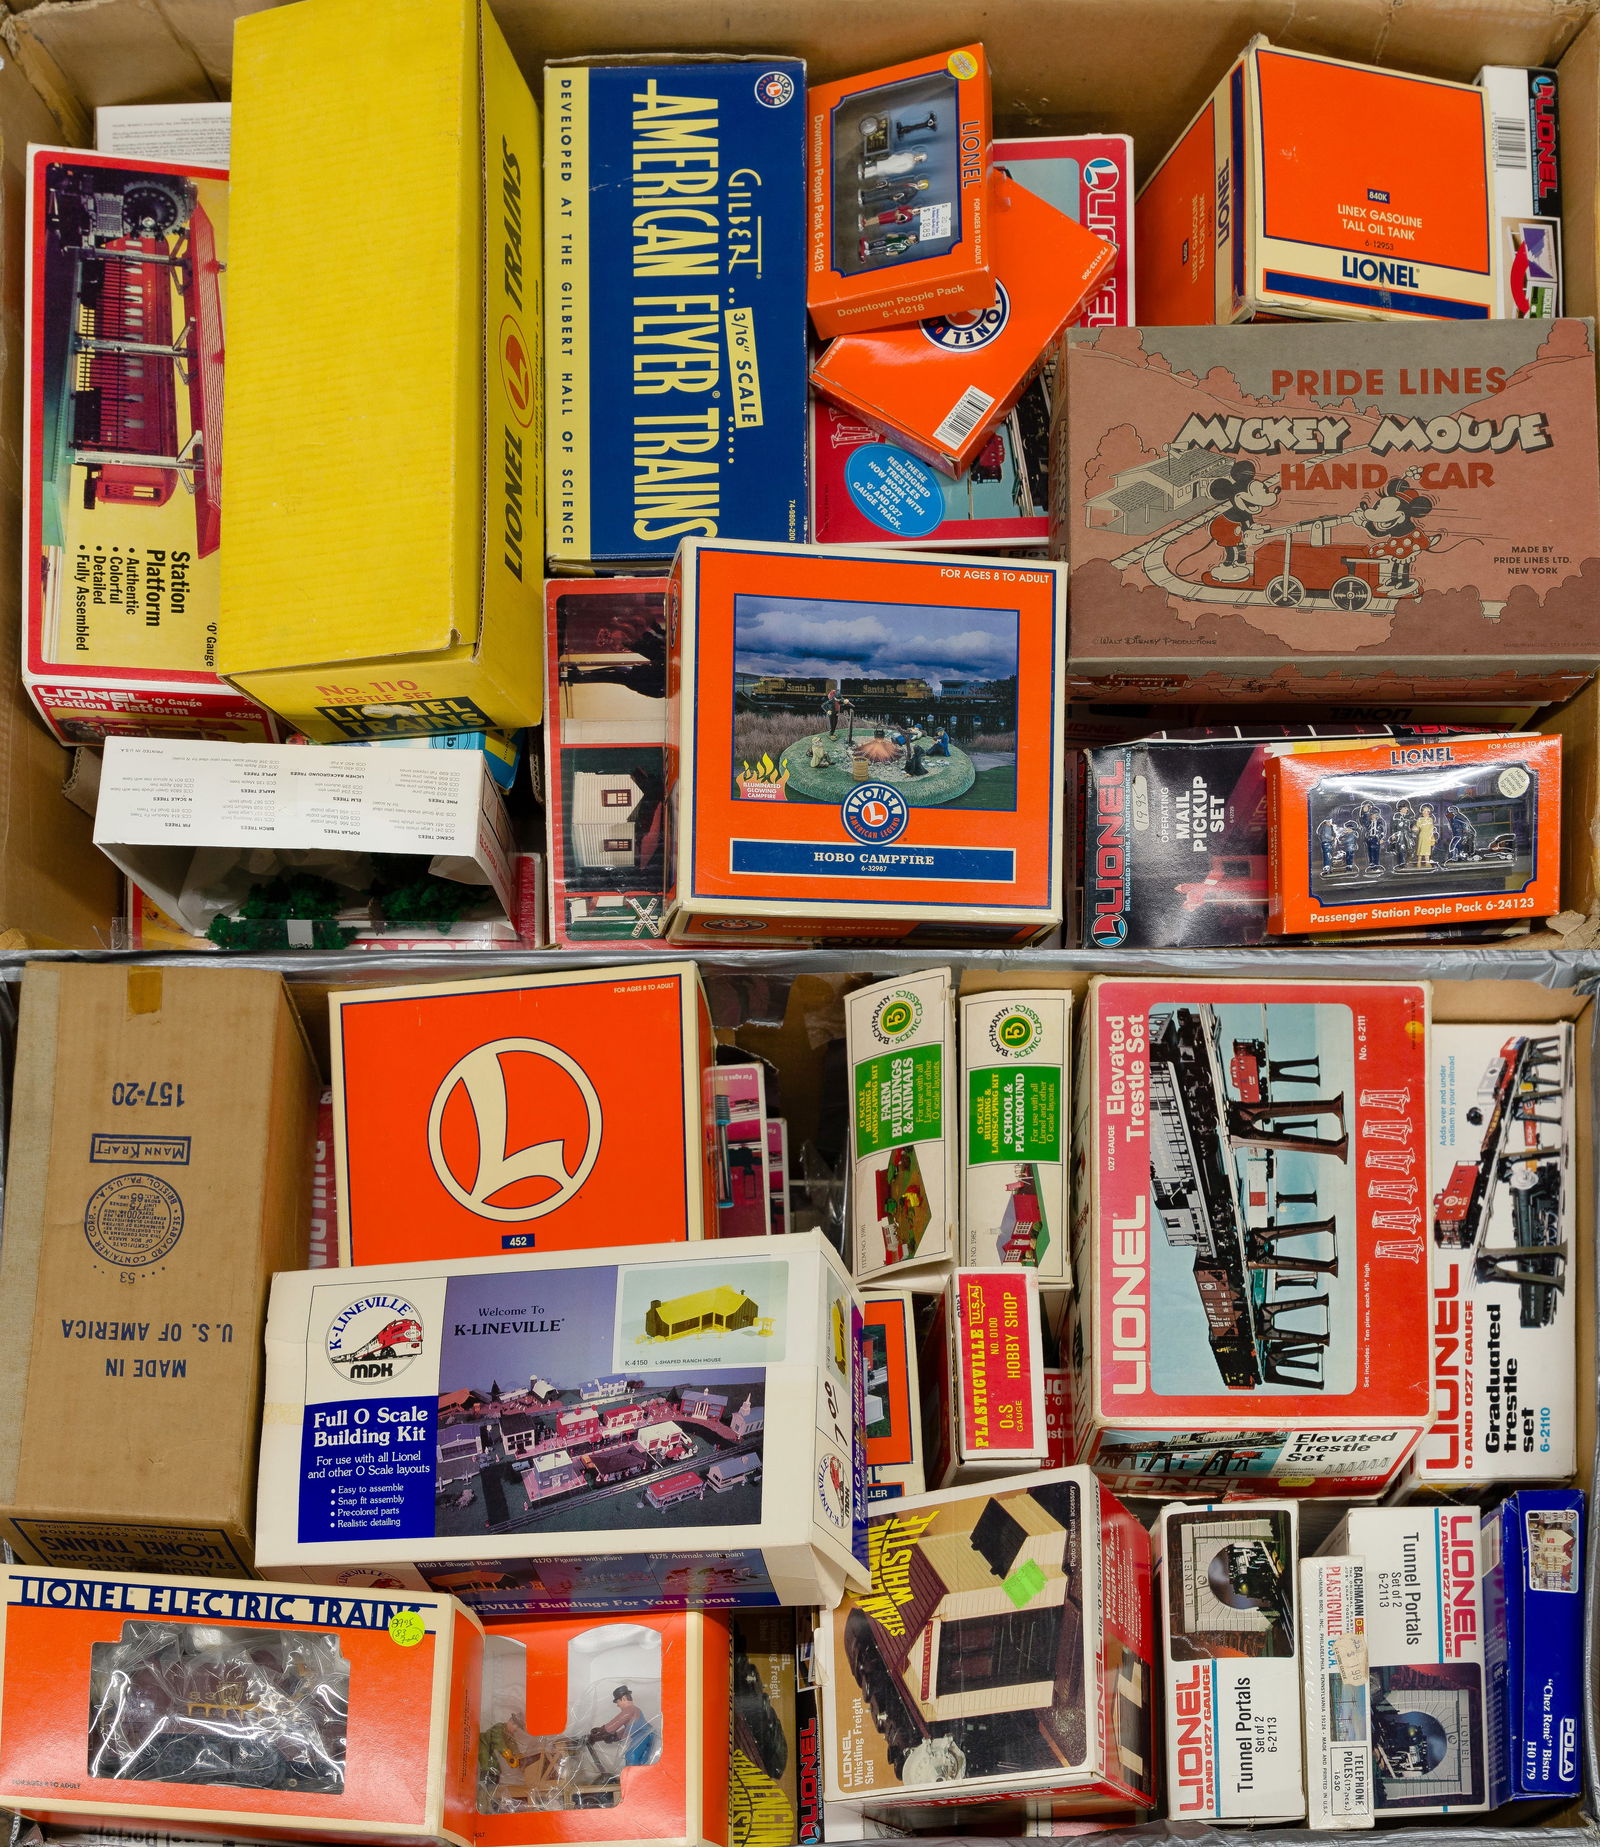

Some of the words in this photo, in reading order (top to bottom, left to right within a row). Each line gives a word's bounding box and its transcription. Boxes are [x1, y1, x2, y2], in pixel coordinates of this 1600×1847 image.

[560, 79, 572, 182] DEVELOPED
[961, 120, 981, 188] LIONEL
[632, 79, 720, 277] AMERICAN
[1368, 191, 1388, 201] 840K
[501, 136, 523, 311] TRAINS
[561, 197, 572, 217] AT
[728, 168, 762, 274] GILBERT
[1337, 203, 1367, 218] LINEX
[1369, 209, 1423, 228] GASOLINE
[1342, 218, 1365, 232] TALL
[1367, 223, 1386, 236] OIL
[1387, 226, 1415, 240] TANK
[561, 234, 572, 265] THE
[1342, 255, 1419, 289] LIONEL
[561, 282, 573, 356] GILBERT
[837, 298, 894, 317] Downtown
[896, 291, 935, 306] People
[936, 283, 965, 297] Pack
[633, 294, 720, 395] FLYER
[561, 373, 573, 416] HALL
[1271, 367, 1384, 396] PRIDE
[1399, 366, 1507, 395] LINES
[561, 431, 573, 453] OF
[1172, 411, 1352, 454] MICKEY
[1368, 411, 1554, 457] MOUSE
[632, 407, 720, 541] TRAINS
[868, 460, 887, 479] NOW
[885, 476, 906, 496] WORK
[904, 495, 925, 516] WITH
[887, 455, 931, 498] REDESIGNED
[887, 465, 921, 501] TRESTLES
[904, 459, 927, 482] THESE
[1281, 463, 1388, 490] HAND
[1420, 462, 1495, 489] CAR
[503, 425, 523, 583] LIONEL
[561, 469, 573, 545] SCIENCE
[853, 480, 878, 506] GAUGE
[875, 503, 901, 530] TRACK.
[872, 489, 890, 507] AND
[879, 484, 900, 505] BOTH
[76, 554, 90, 583] Fully
[92, 555, 107, 605] Detailed
[109, 556, 123, 605] Colorful
[125, 556, 140, 616] Authentic
[146, 549, 166, 627] Platform
[171, 550, 190, 614] Station
[940, 568, 960, 579] FOR
[963, 570, 991, 581] AGES
[992, 572, 1000, 581] 8
[1002, 572, 1016, 582] TO
[1018, 574, 1049, 584] ADULT
[76, 587, 90, 650] Assembled
[1391, 747, 1454, 765] LIONEL
[747, 787, 777, 795] GLOWING
[1160, 787, 1170, 843] OPERATING
[1175, 790, 1190, 840] MAIL
[1193, 775, 1208, 852] PICKUP
[1210, 795, 1225, 833] SET
[1096, 759, 1125, 915] LIONEL
[813, 851, 855, 863] HOBO
[859, 853, 934, 866] CAMPFIRE
[1310, 910, 1368, 924] Passenger
[1371, 908, 1410, 920] Station
[1413, 904, 1446, 917] People
[1455, 901, 1482, 913] Pack
[1485, 897, 1535, 911] 6-24123
[1126, 1014, 1145, 1054] Set
[1106, 1015, 1125, 1115] Elevated
[1439, 1065, 1447, 1088] under
[111, 1082, 186, 1108] 157-20
[880, 1080, 891, 1121] FARM
[891, 1058, 902, 1138] BUILDINGS
[1003, 1083, 1014, 1093] &
[1125, 1060, 1145, 1142] Trestle
[1439, 1089, 1447, 1105] and
[1449, 1088, 1457, 1106] your
[1003, 1095, 1014, 1145] SCHOOL
[1014, 1072, 1025, 1153] PLAYGROUND
[1448, 1107, 1455, 1115] to
[1439, 1125, 1447, 1146] Adds
[510, 1236, 527, 1247] 452
[478, 1307, 527, 1318] Welcome
[530, 1305, 545, 1315] To
[1003, 1291, 1018, 1328] SHOP
[1111, 1195, 1147, 1395] LIONEL
[454, 1319, 561, 1336] K-LINEVILLE
[105, 1358, 124, 1377] IN
[133, 1359, 187, 1378] MADE
[349, 1362, 393, 1379] MDK
[1005, 1334, 1021, 1379] HOBBY
[970, 1328, 989, 1448] PLASTICVILLE
[1485, 1304, 1501, 1454] Graduated
[313, 1409, 348, 1428] Full
[353, 1408, 370, 1425] O
[376, 1405, 429, 1423] Scale
[1015, 1400, 1024, 1432] GAUGE
[1503, 1358, 1517, 1453] trestle
[313, 1428, 391, 1447] Building
[396, 1425, 426, 1442] Kit
[1293, 1442, 1371, 1453] Trestle
[1295, 1431, 1399, 1444] Elevated
[1521, 1407, 1534, 1453] set
[1539, 1407, 1550, 1452] 6-2110
[316, 1455, 332, 1467] For
[335, 1456, 352, 1465] use
[354, 1452, 375, 1463] with
[377, 1452, 389, 1463] all
[391, 1450, 421, 1462] Lionel
[1285, 1453, 1326, 1463] Set
[337, 1497, 357, 1507] Snap
[360, 1496, 368, 1505] fit
[369, 1495, 405, 1505] assembly
[338, 1485, 356, 1495] Easy
[359, 1485, 367, 1493] to
[369, 1483, 404, 1493] assemble
[648, 1552, 669, 1560] 4175
[671, 1551, 703, 1560] Animals
[705, 1551, 722, 1559] with
[722, 1550, 745, 1559] paint
[880, 1510, 940, 1602] WHISTLE
[1403, 1532, 1421, 1586] Tunnel
[21, 1578, 148, 1612] LIONEL
[150, 1588, 303, 1624] ELECTRIC
[1378, 1573, 1389, 1608] 6-2113
[1450, 1515, 1477, 1658] LIONEL
[856, 1599, 906, 1637] STEAM
[1404, 1592, 1422, 1645] Portals
[852, 1697, 863, 1735] Freight
[1234, 1677, 1252, 1731] Portals
[1176, 1664, 1204, 1811] LIONEL
[1267, 1717, 1278, 1753] 6-2113
[1563, 1717, 1575, 1775] POLA
[799, 1717, 818, 1823] LIONEL
[842, 1730, 853, 1787] LIONEL
[853, 1738, 864, 1786] Whistling
[1235, 1737, 1254, 1793] Tunnel
[1333, 1771, 1341, 1791] 1630
